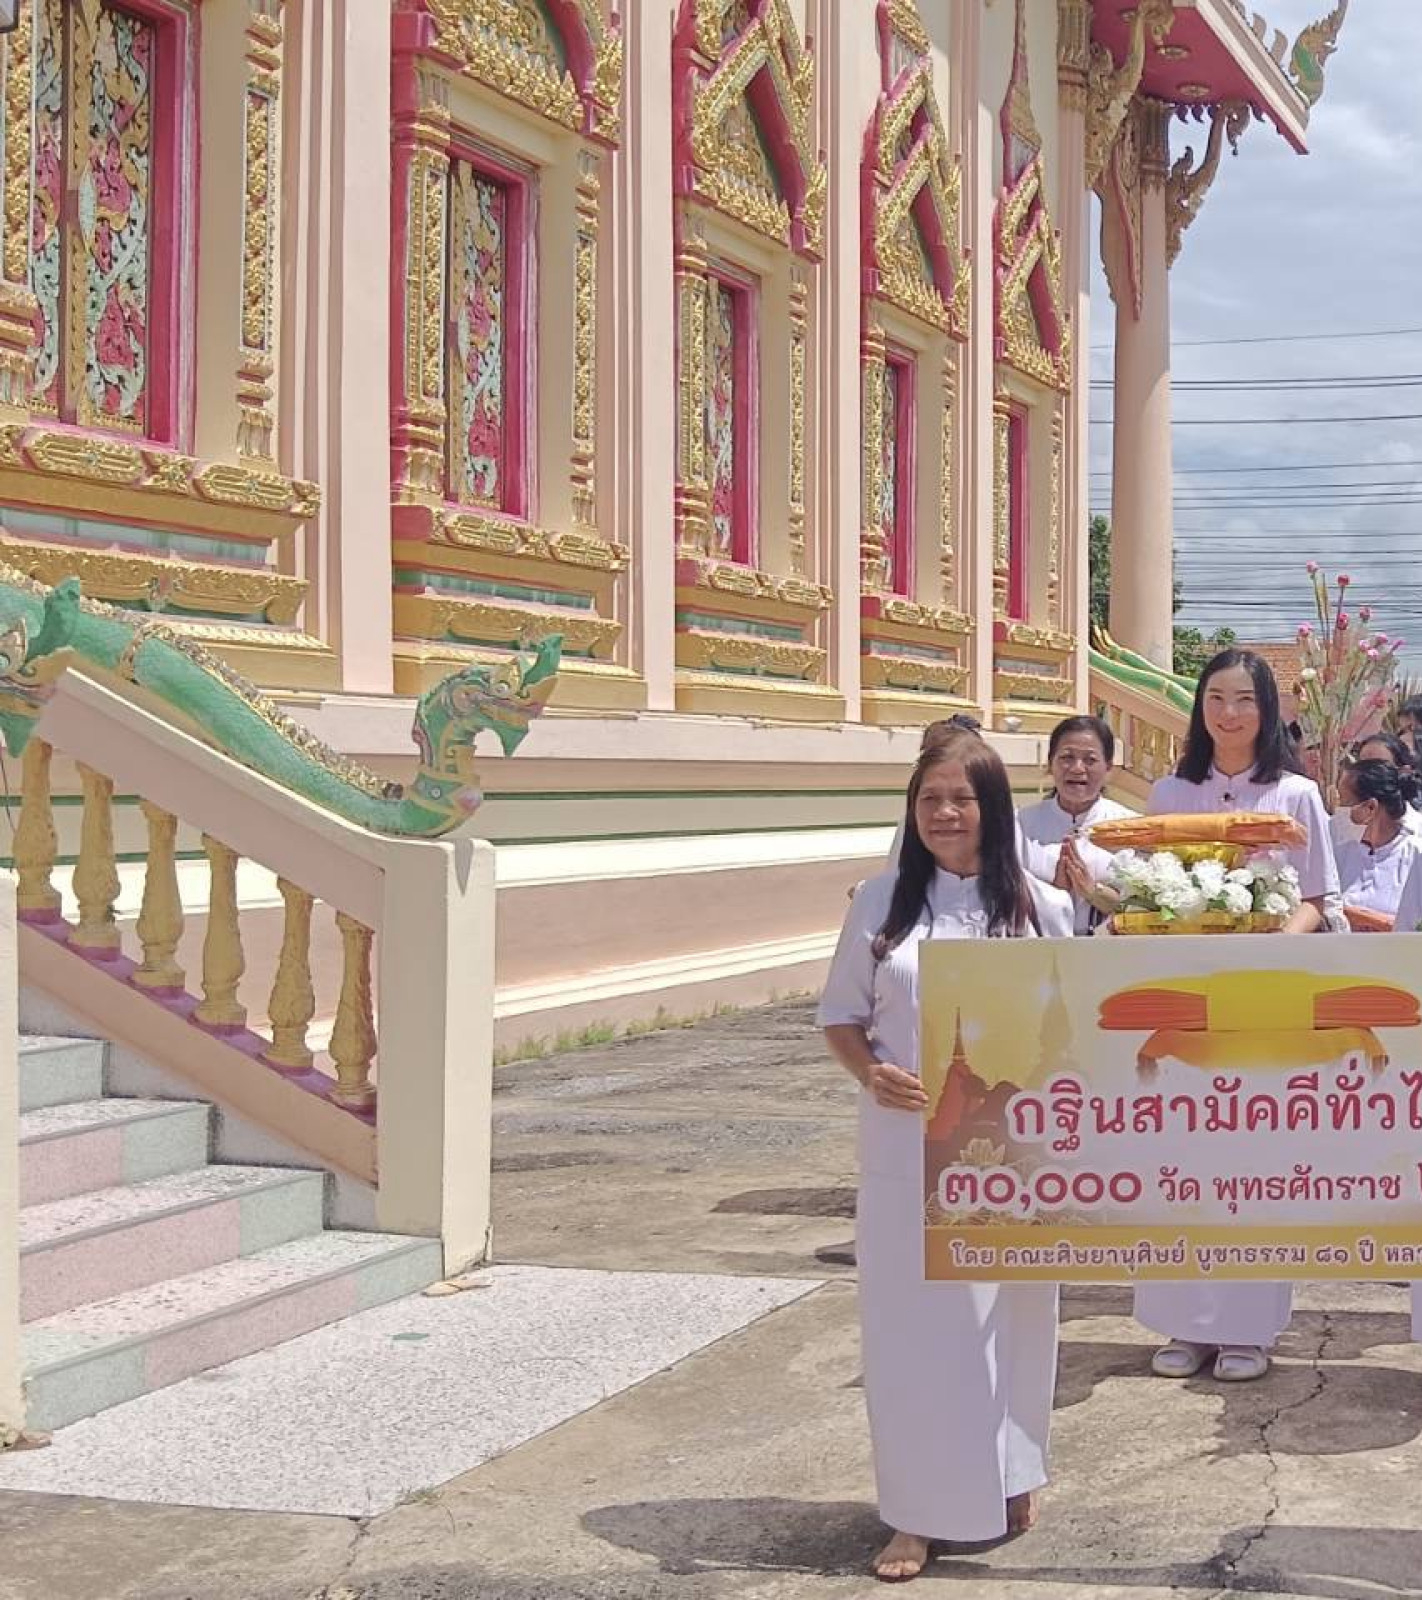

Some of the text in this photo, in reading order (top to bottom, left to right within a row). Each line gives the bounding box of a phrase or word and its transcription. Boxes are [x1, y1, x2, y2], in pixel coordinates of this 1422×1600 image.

[945, 1172, 1142, 1211] ๓๐,๐๐๐
[1157, 1166, 1201, 1202] วัด
[1212, 1164, 1402, 1214] พุทธศักราช
[951, 1241, 994, 1264] โดย
[1004, 1238, 1185, 1270] คณะศิษยานุศิษย์
[1195, 1246, 1306, 1271] บูชาธรรม
[1315, 1248, 1349, 1264] ๘๑
[1359, 1238, 1374, 1263] ปี
